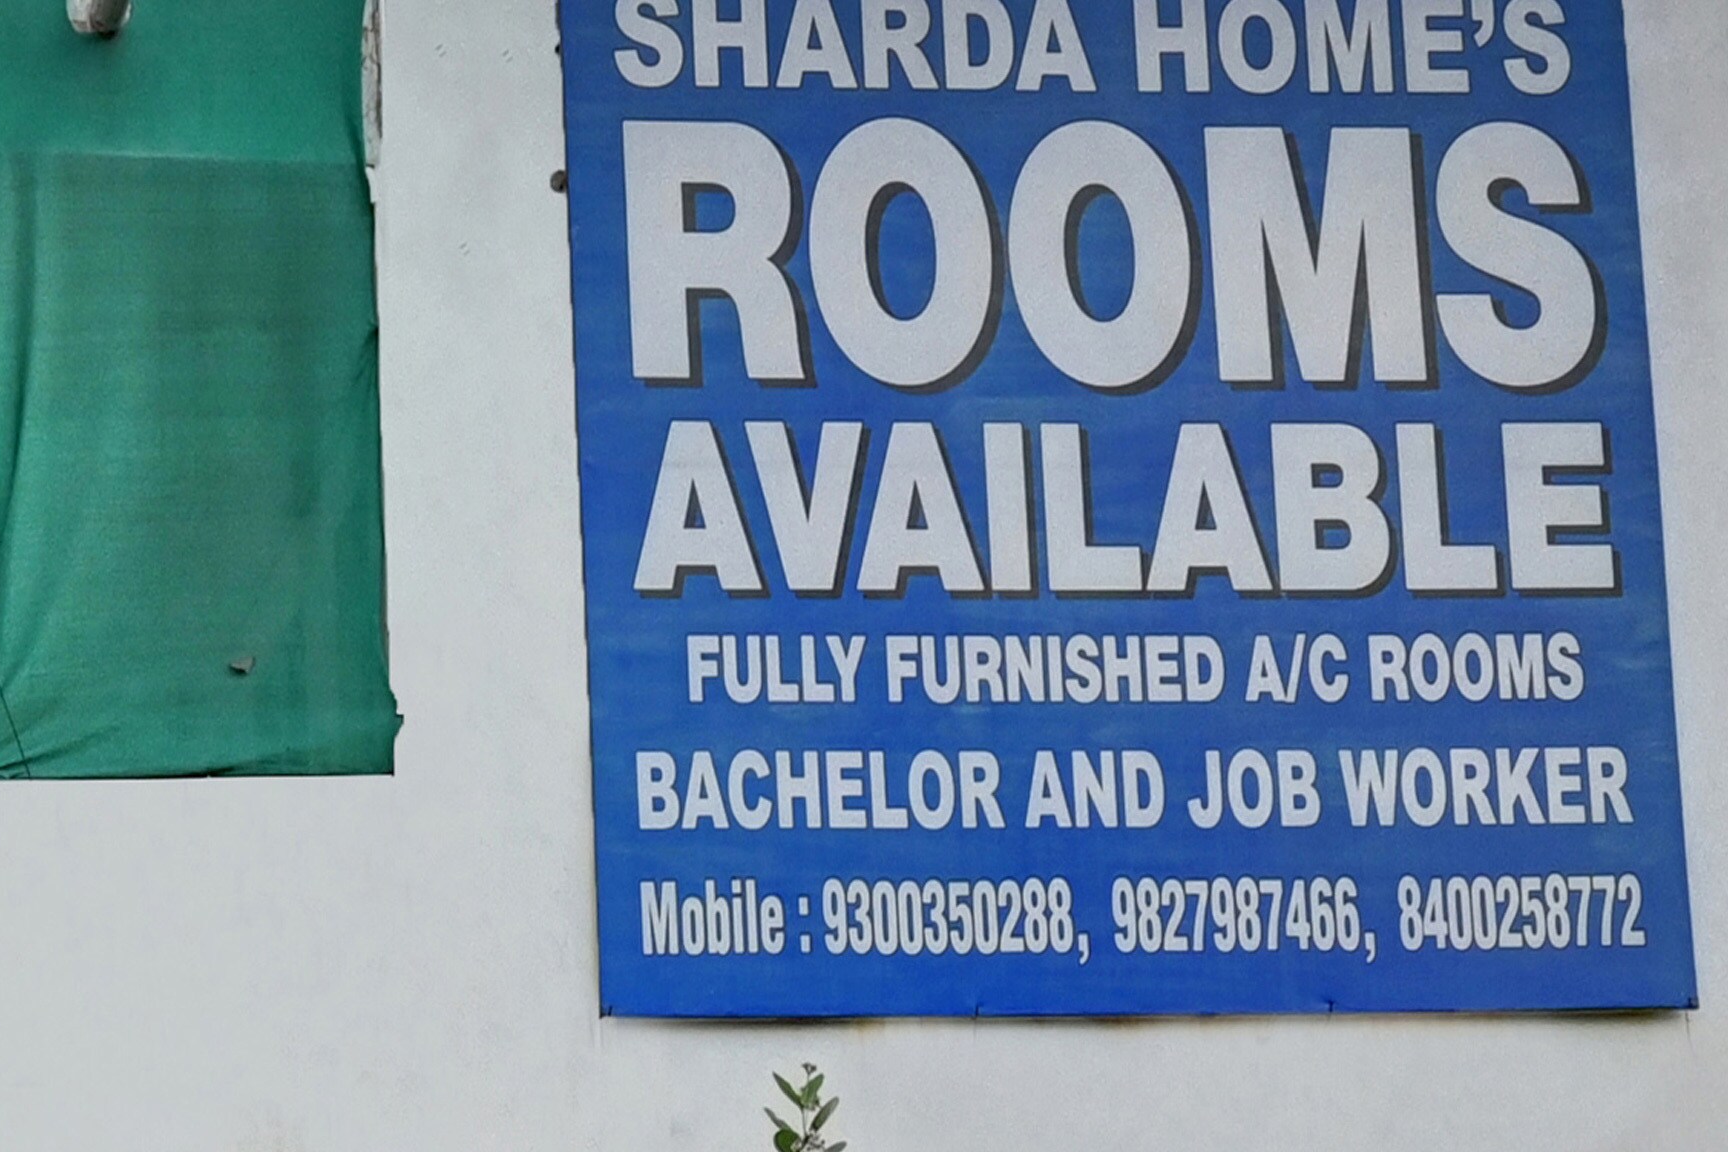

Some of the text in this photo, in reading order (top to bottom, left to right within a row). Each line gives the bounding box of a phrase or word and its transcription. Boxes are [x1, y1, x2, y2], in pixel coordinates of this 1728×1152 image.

[613, 0, 1570, 94] SHARDA HOME'S
[622, 117, 1604, 394] ROOMS
[633, 421, 1622, 597] AVAILABLE
[686, 632, 1585, 704] FULLY FURNISHED A/C ROOMS
[635, 747, 1633, 830] BACHELOR AND JOB WORKER
[822, 878, 1090, 965] 9300350288,
[1112, 876, 1376, 963] 9827987466,
[1396, 873, 1646, 951] 8400258772
